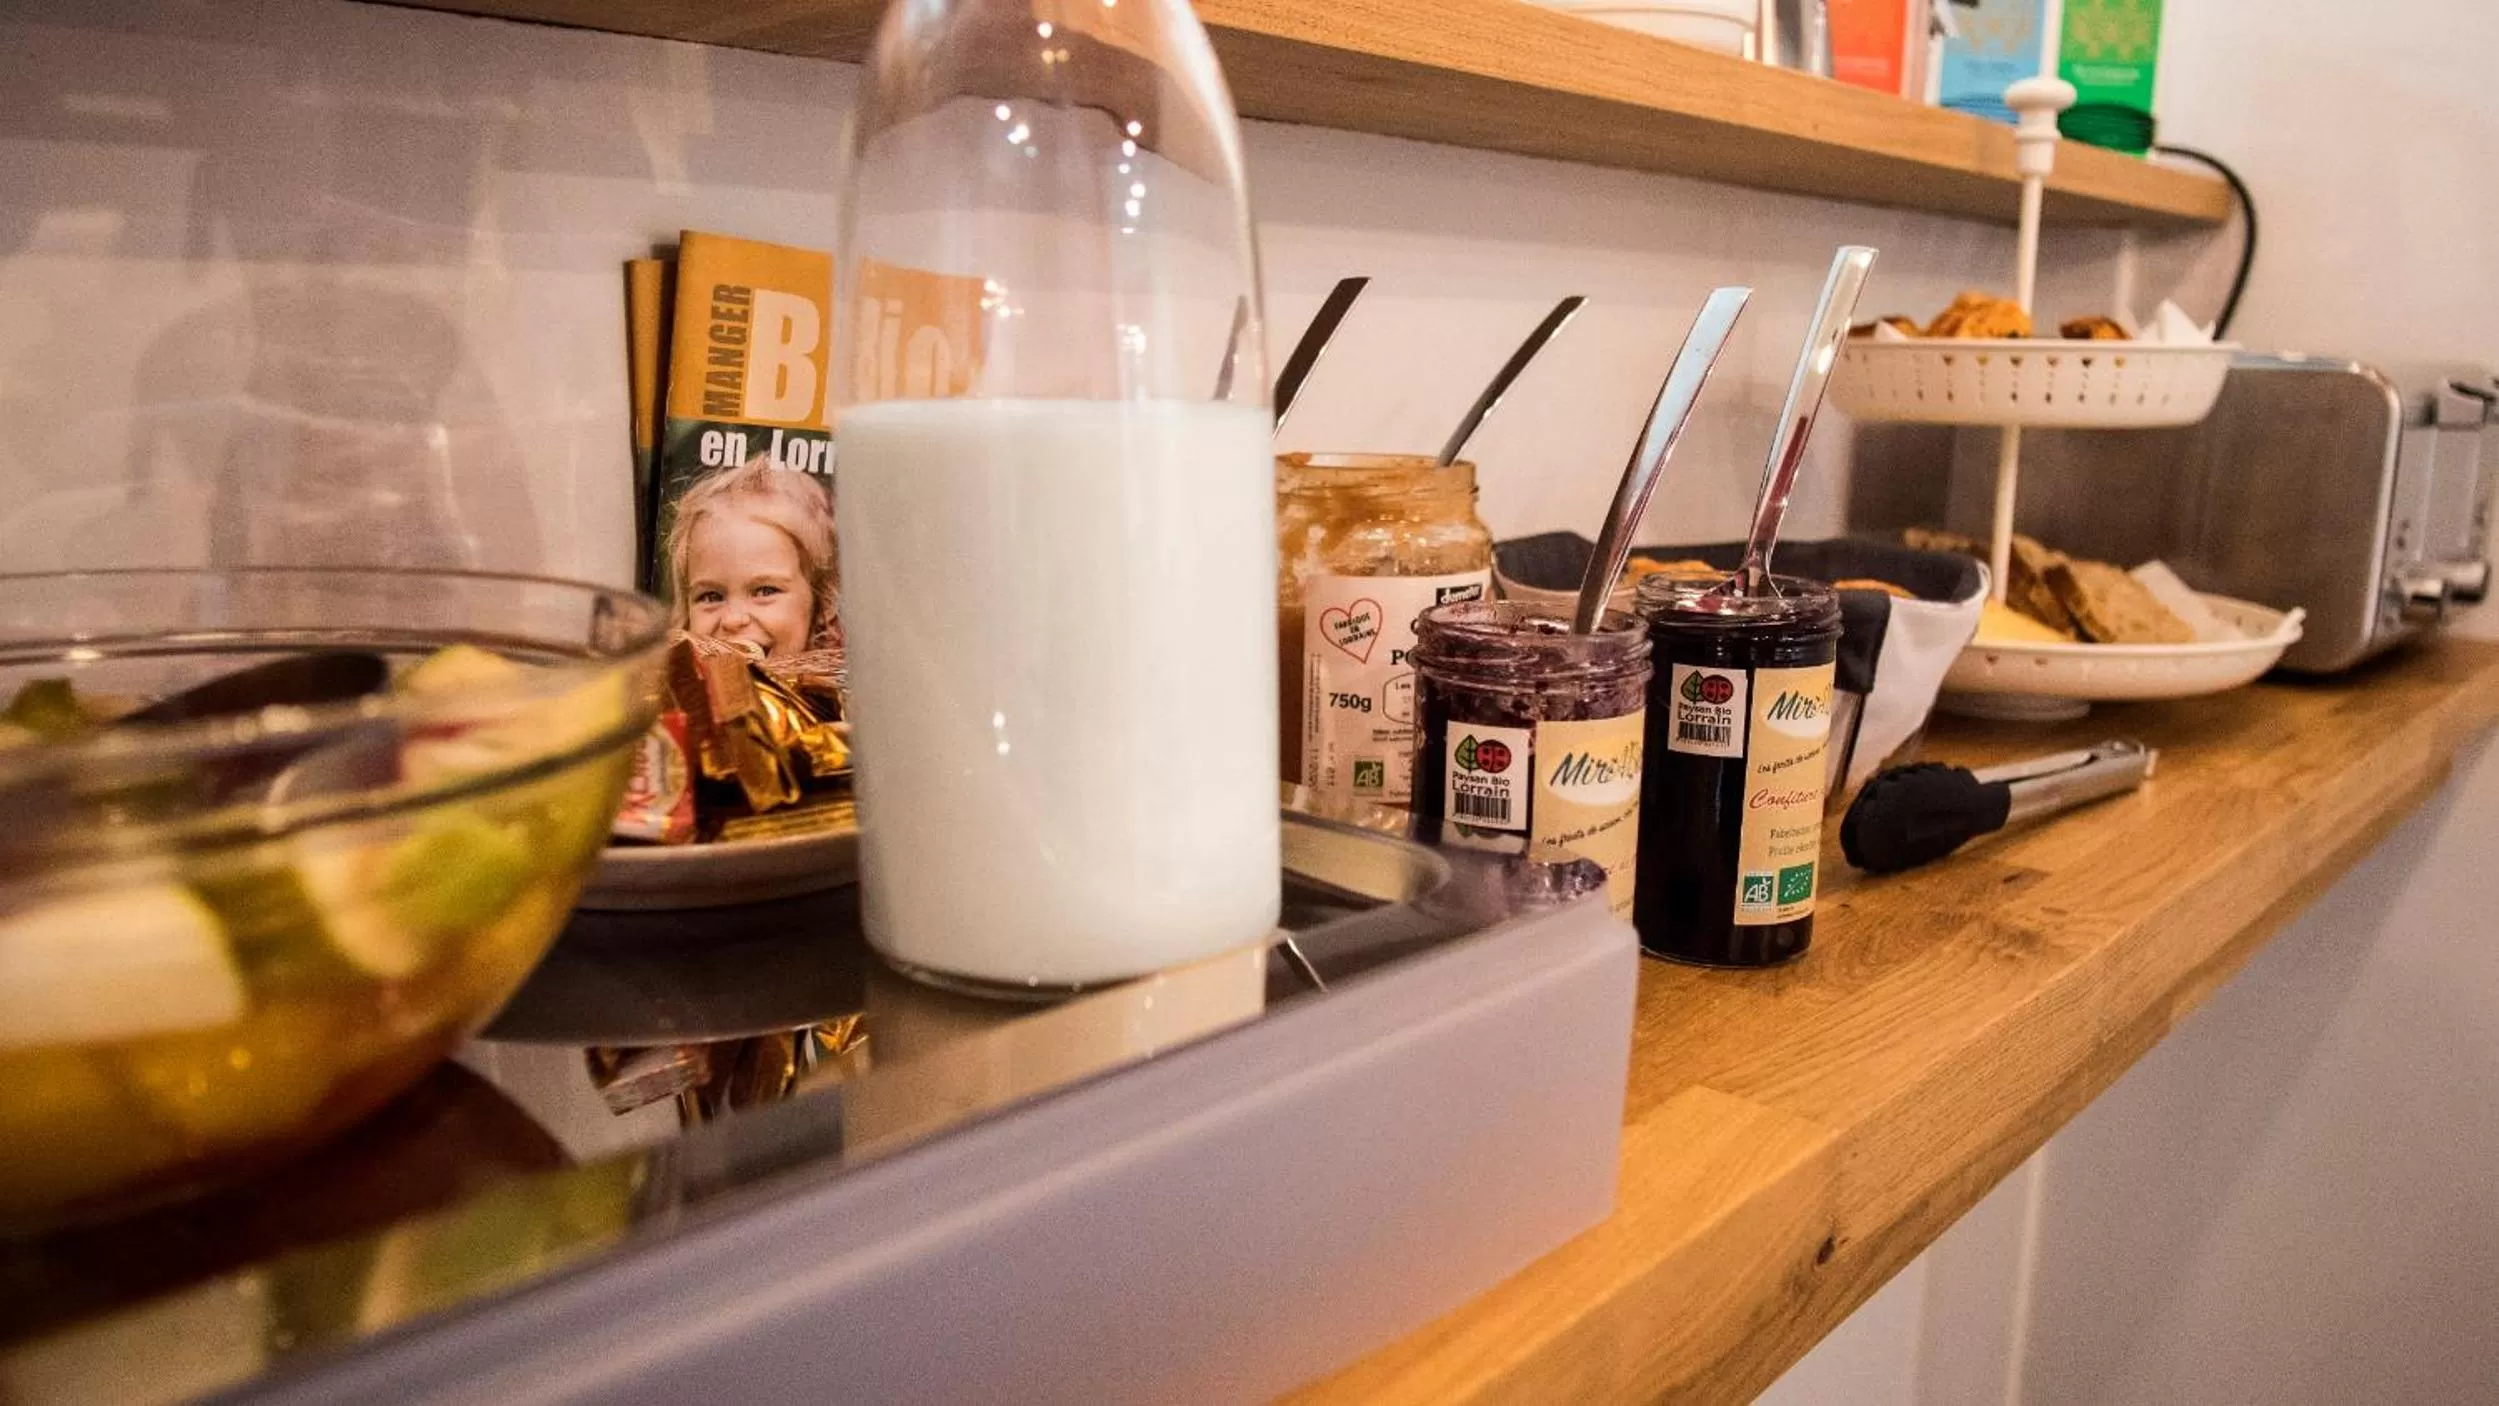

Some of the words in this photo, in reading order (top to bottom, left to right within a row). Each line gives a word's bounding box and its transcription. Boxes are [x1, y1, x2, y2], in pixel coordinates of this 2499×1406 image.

[703, 284, 752, 418] MANGER
[701, 430, 747, 468] en
[1328, 692, 1372, 713] 750g
[1678, 711, 1731, 725] Lorrain
[1452, 770, 1488, 784] Paysan
[1491, 775, 1510, 787] Bio
[1452, 780, 1510, 797] Lorrain
